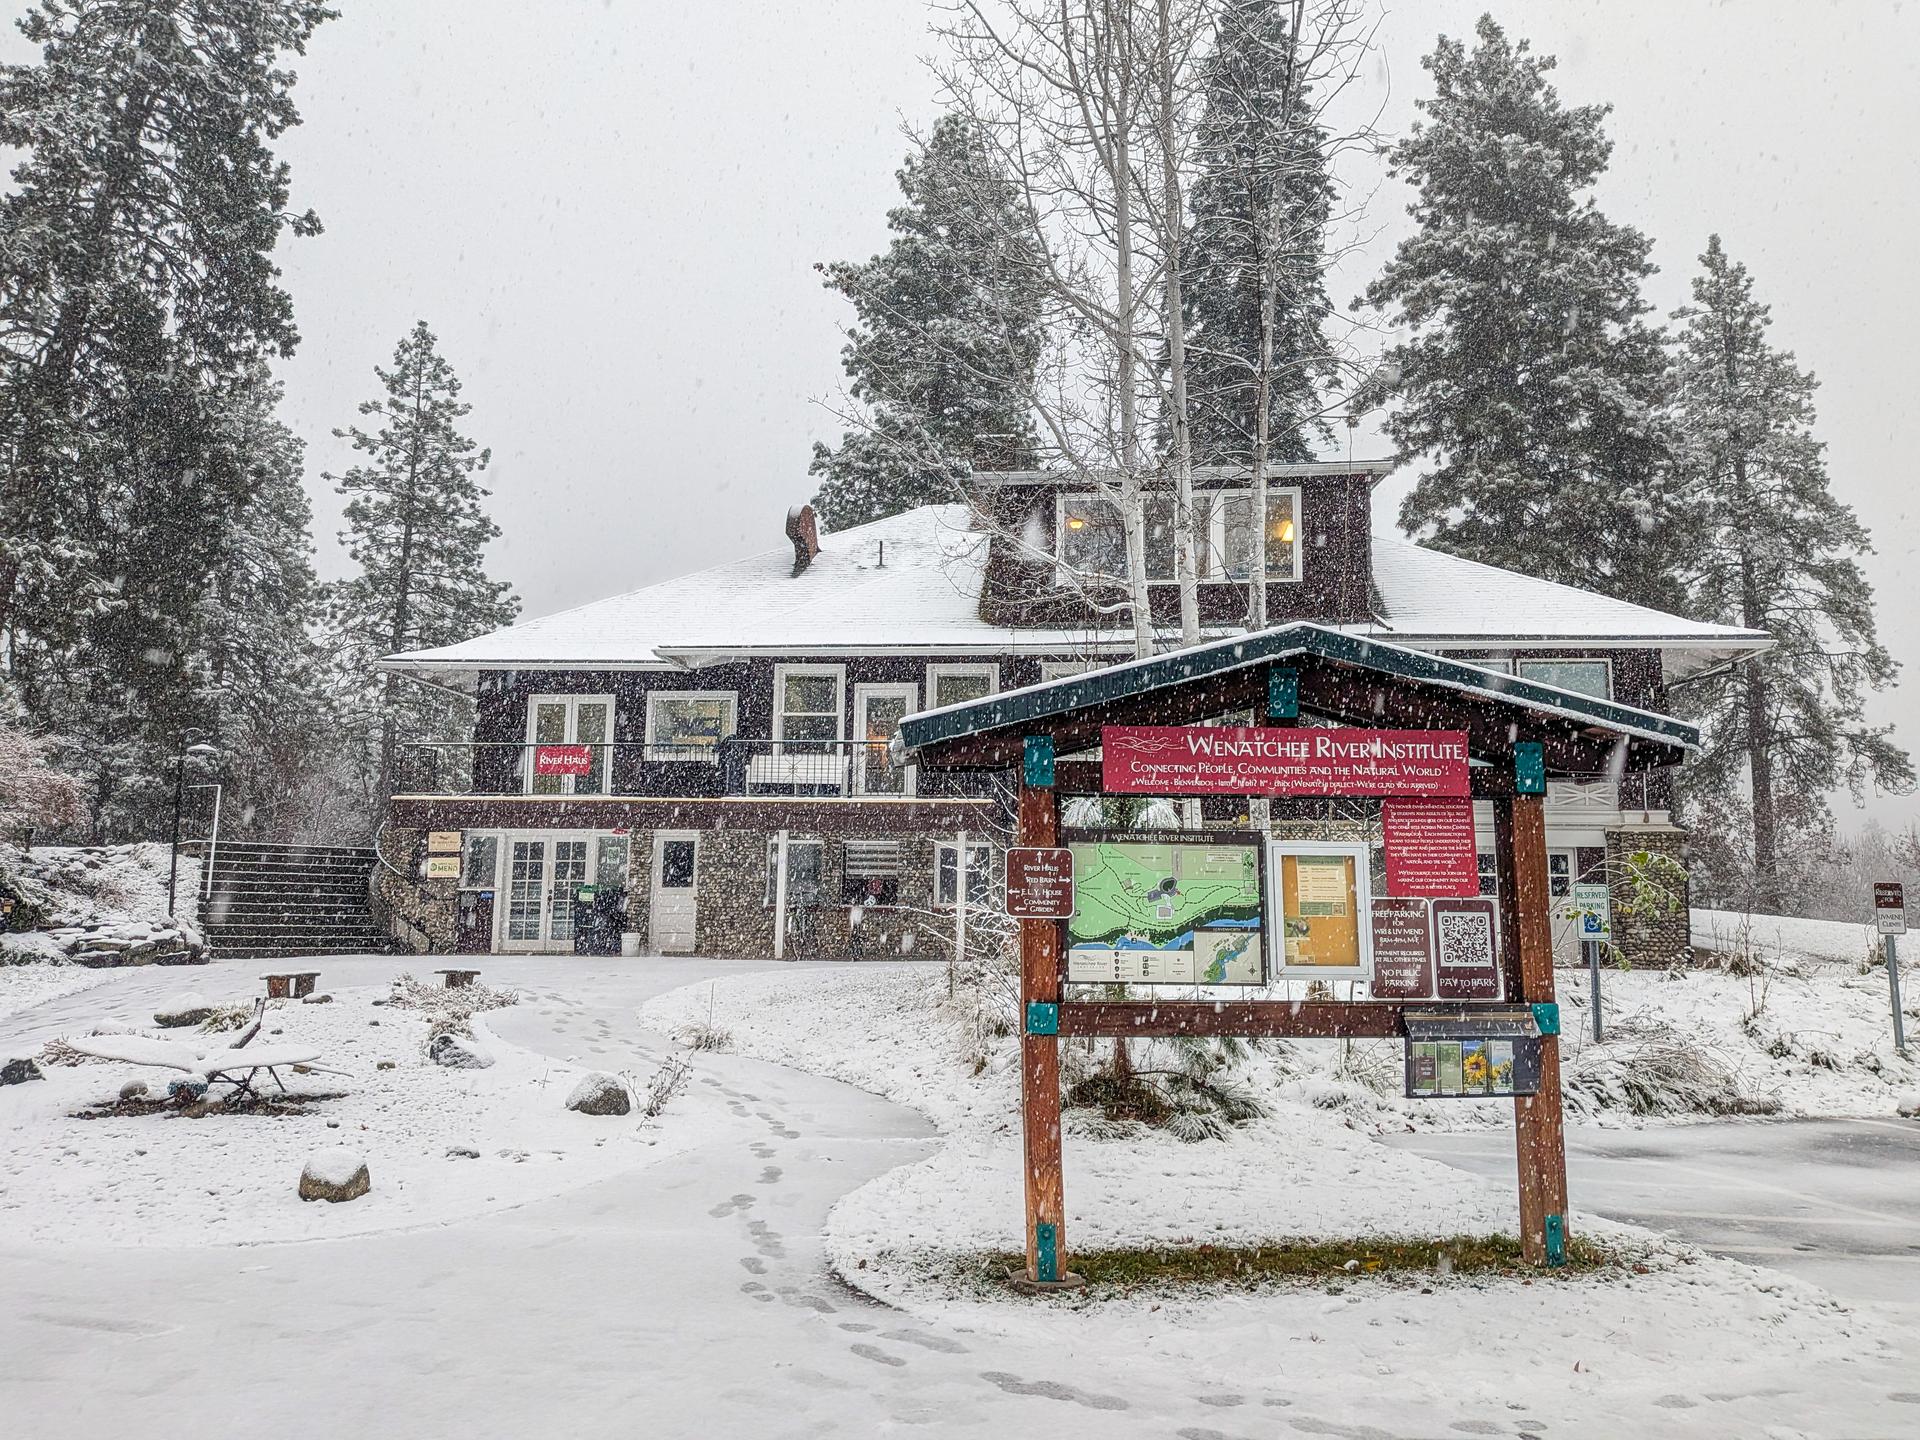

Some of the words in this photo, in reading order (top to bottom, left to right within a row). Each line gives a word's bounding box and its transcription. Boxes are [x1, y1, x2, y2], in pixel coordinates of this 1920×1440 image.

[1187, 734, 1310, 759] WENATCHEE
[1316, 736, 1371, 759] RIVER
[1376, 737, 1463, 760] INSTITUTE
[540, 755, 561, 764] RIVER
[564, 755, 587, 764] HAUS
[1131, 761, 1196, 773] CONNECTING
[1198, 763, 1236, 775] PEOPLE,
[1238, 763, 1307, 775] COMMUNITIES
[1309, 766, 1332, 775] AND
[1334, 766, 1350, 775] THE
[1353, 765, 1400, 776] NATURAL
[1403, 765, 1442, 776] WORLD
[1136, 778, 1169, 786] WELCOME
